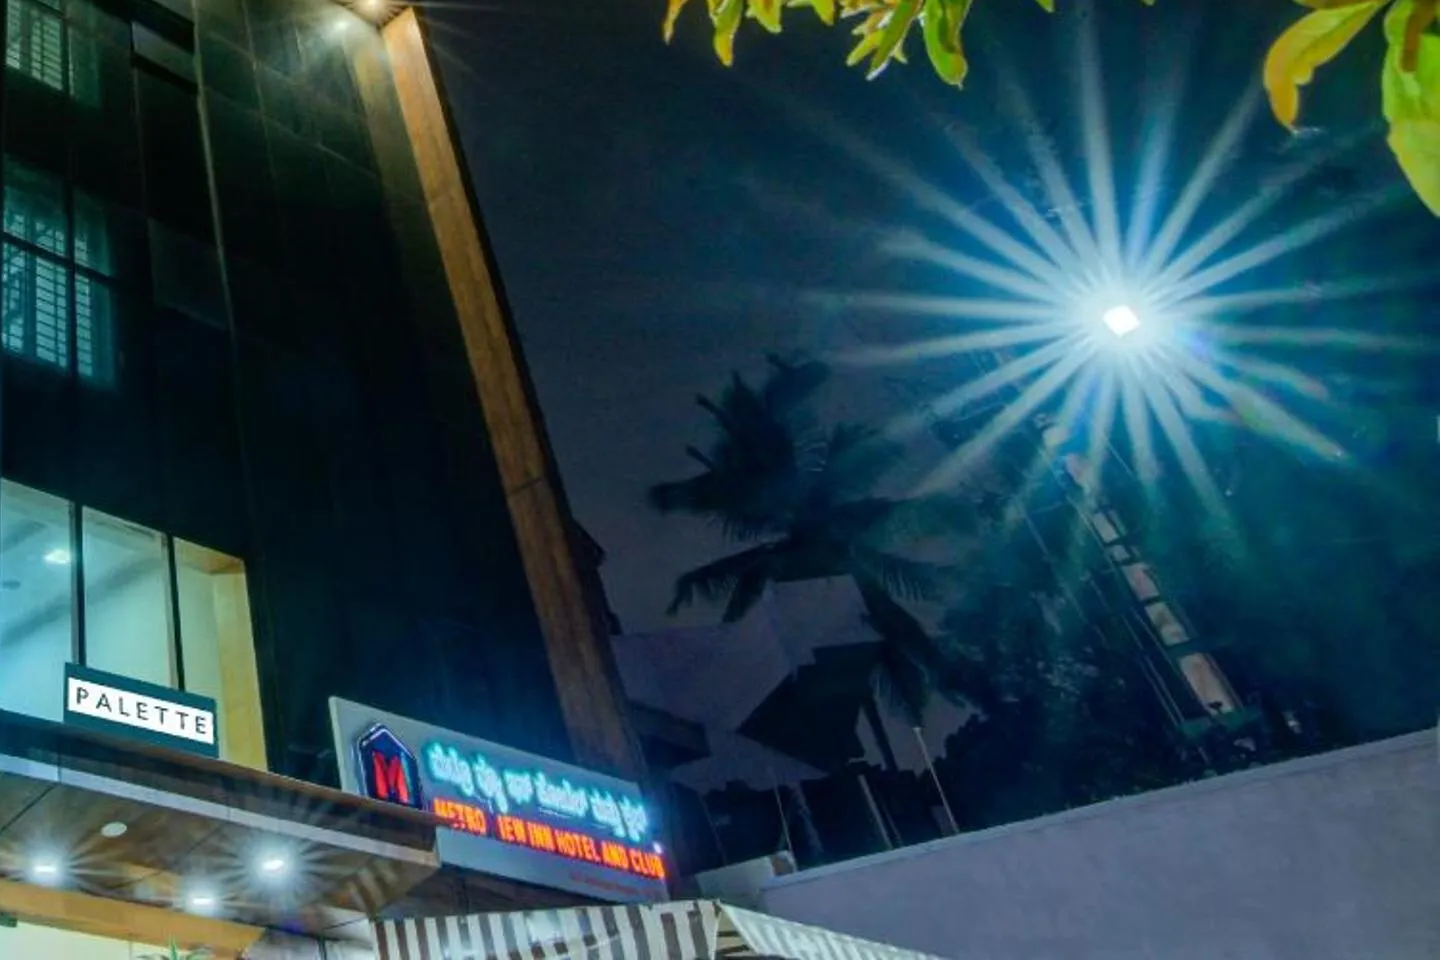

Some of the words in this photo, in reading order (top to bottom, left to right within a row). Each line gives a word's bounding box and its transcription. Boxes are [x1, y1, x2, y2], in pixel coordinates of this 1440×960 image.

[75, 686, 208, 735] PALETTE
[554, 828, 601, 861] HOTEL
[601, 839, 629, 870] AND
[629, 847, 666, 880] CLUB
